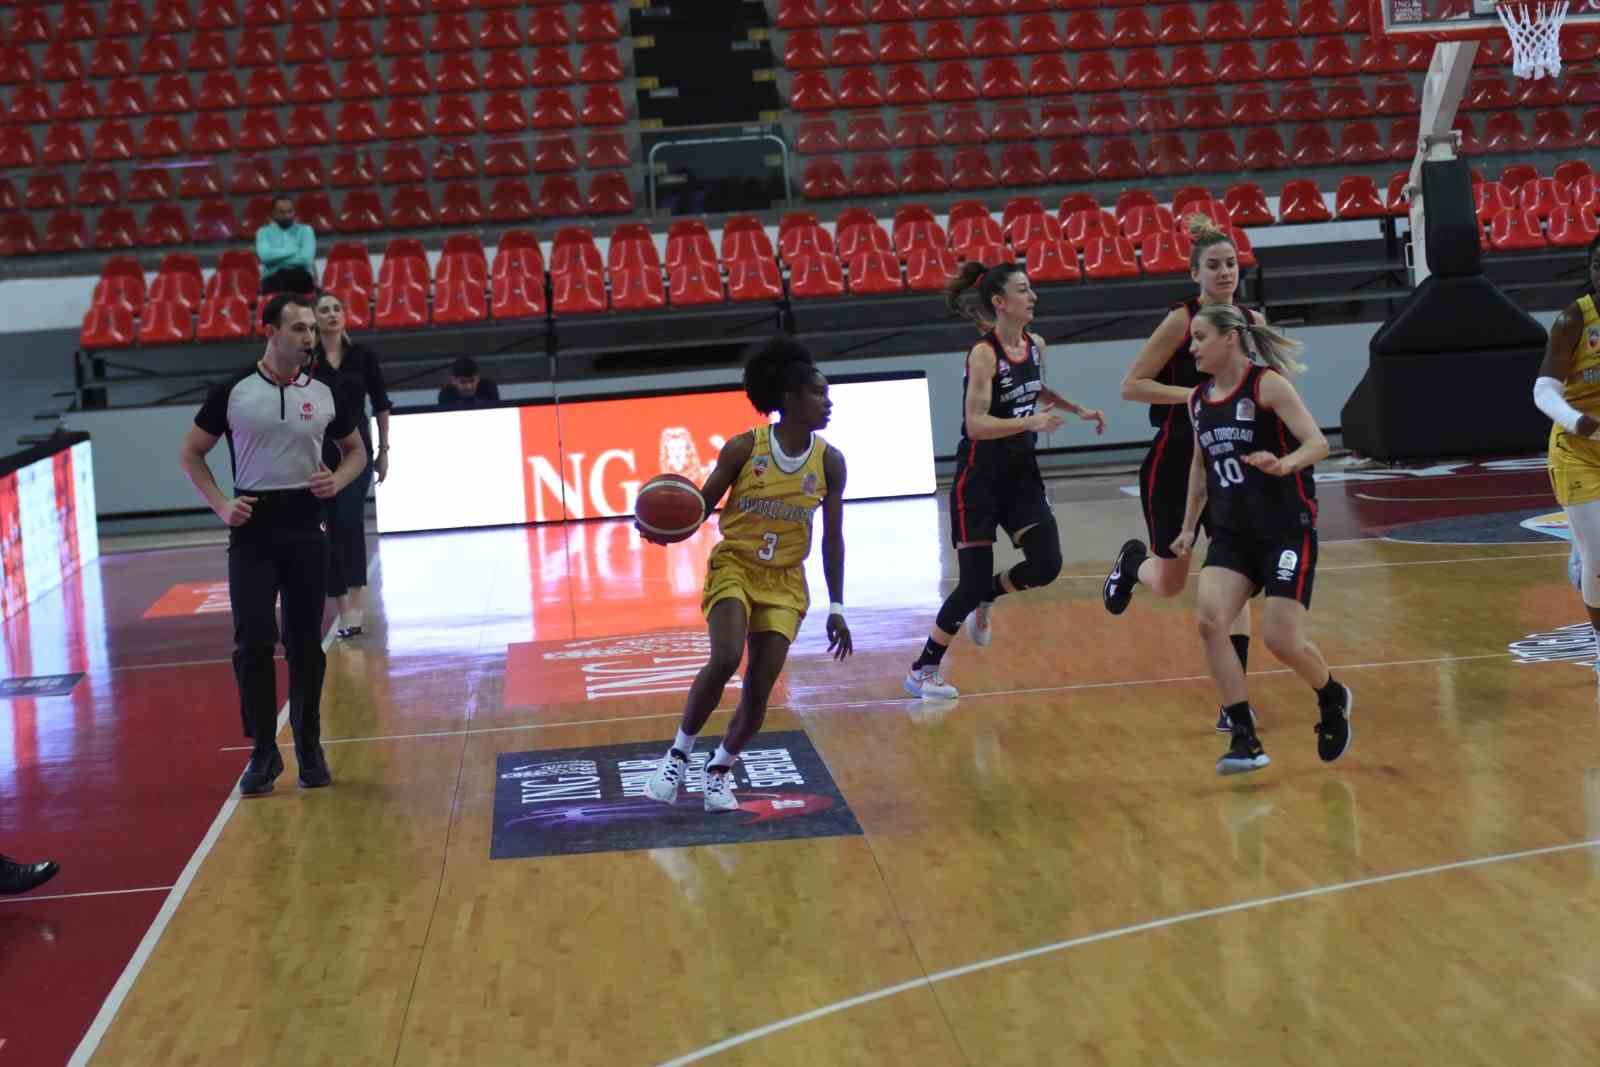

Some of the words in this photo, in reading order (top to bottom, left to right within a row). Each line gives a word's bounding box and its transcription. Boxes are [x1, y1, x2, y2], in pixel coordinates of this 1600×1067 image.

[1213, 457, 1244, 488] 10
[758, 531, 778, 561] 3
[520, 776, 602, 804] ING
